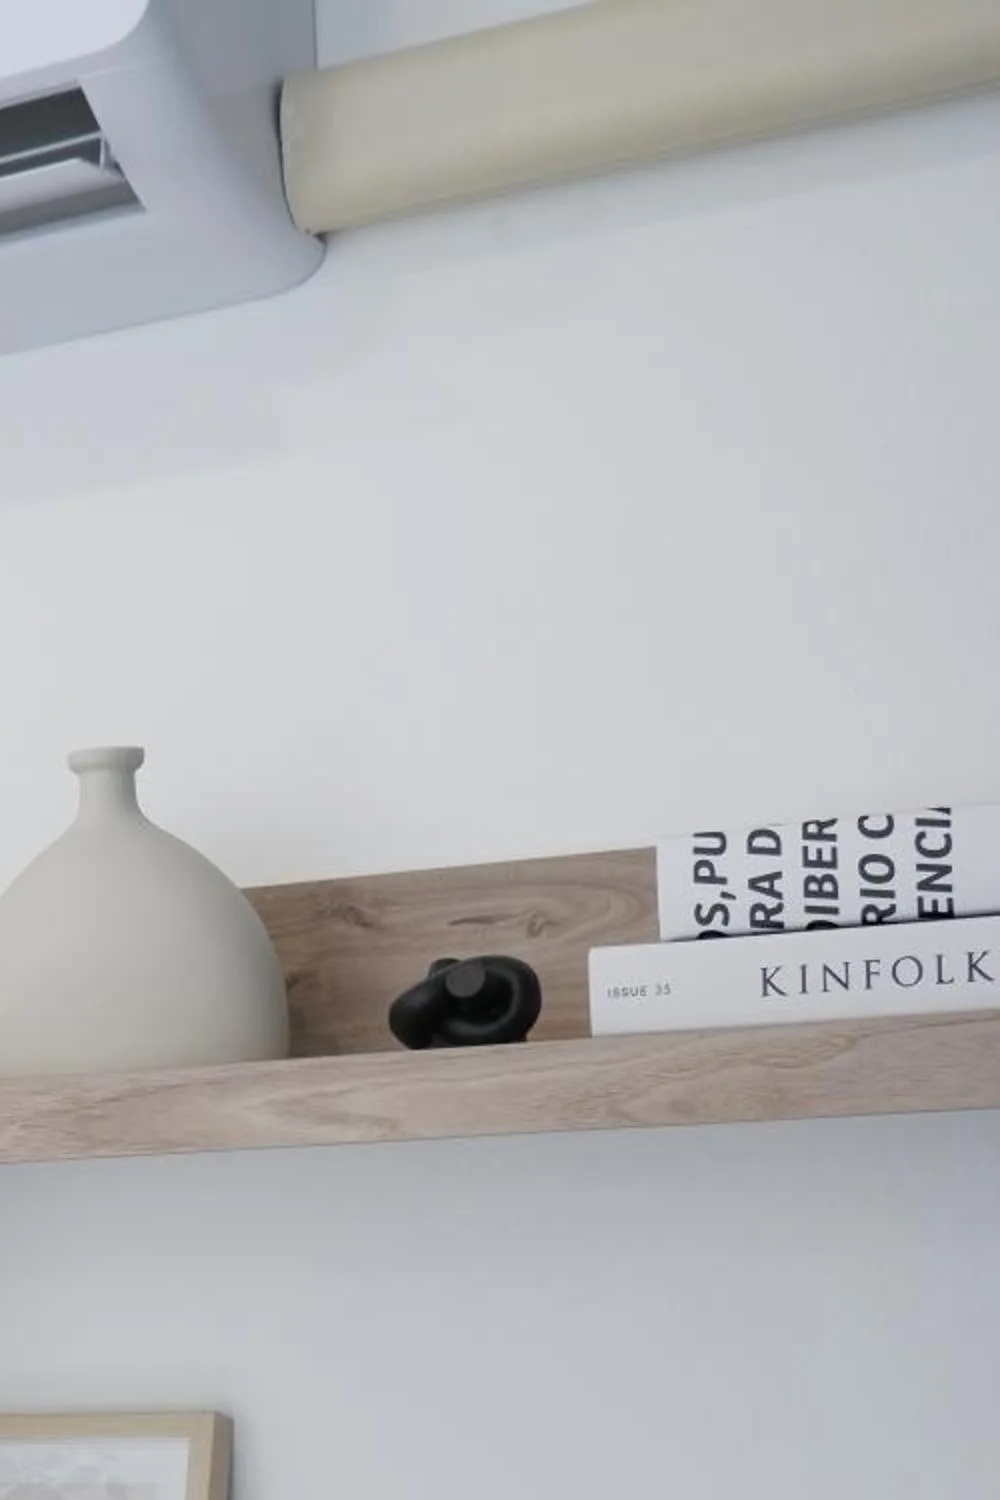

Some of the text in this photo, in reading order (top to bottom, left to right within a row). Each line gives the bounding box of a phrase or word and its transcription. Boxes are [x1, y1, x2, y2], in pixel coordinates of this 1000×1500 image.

[747, 828, 782, 856] D
[760, 950, 995, 998] KINFOLK
[607, 985, 648, 999] ISSUE
